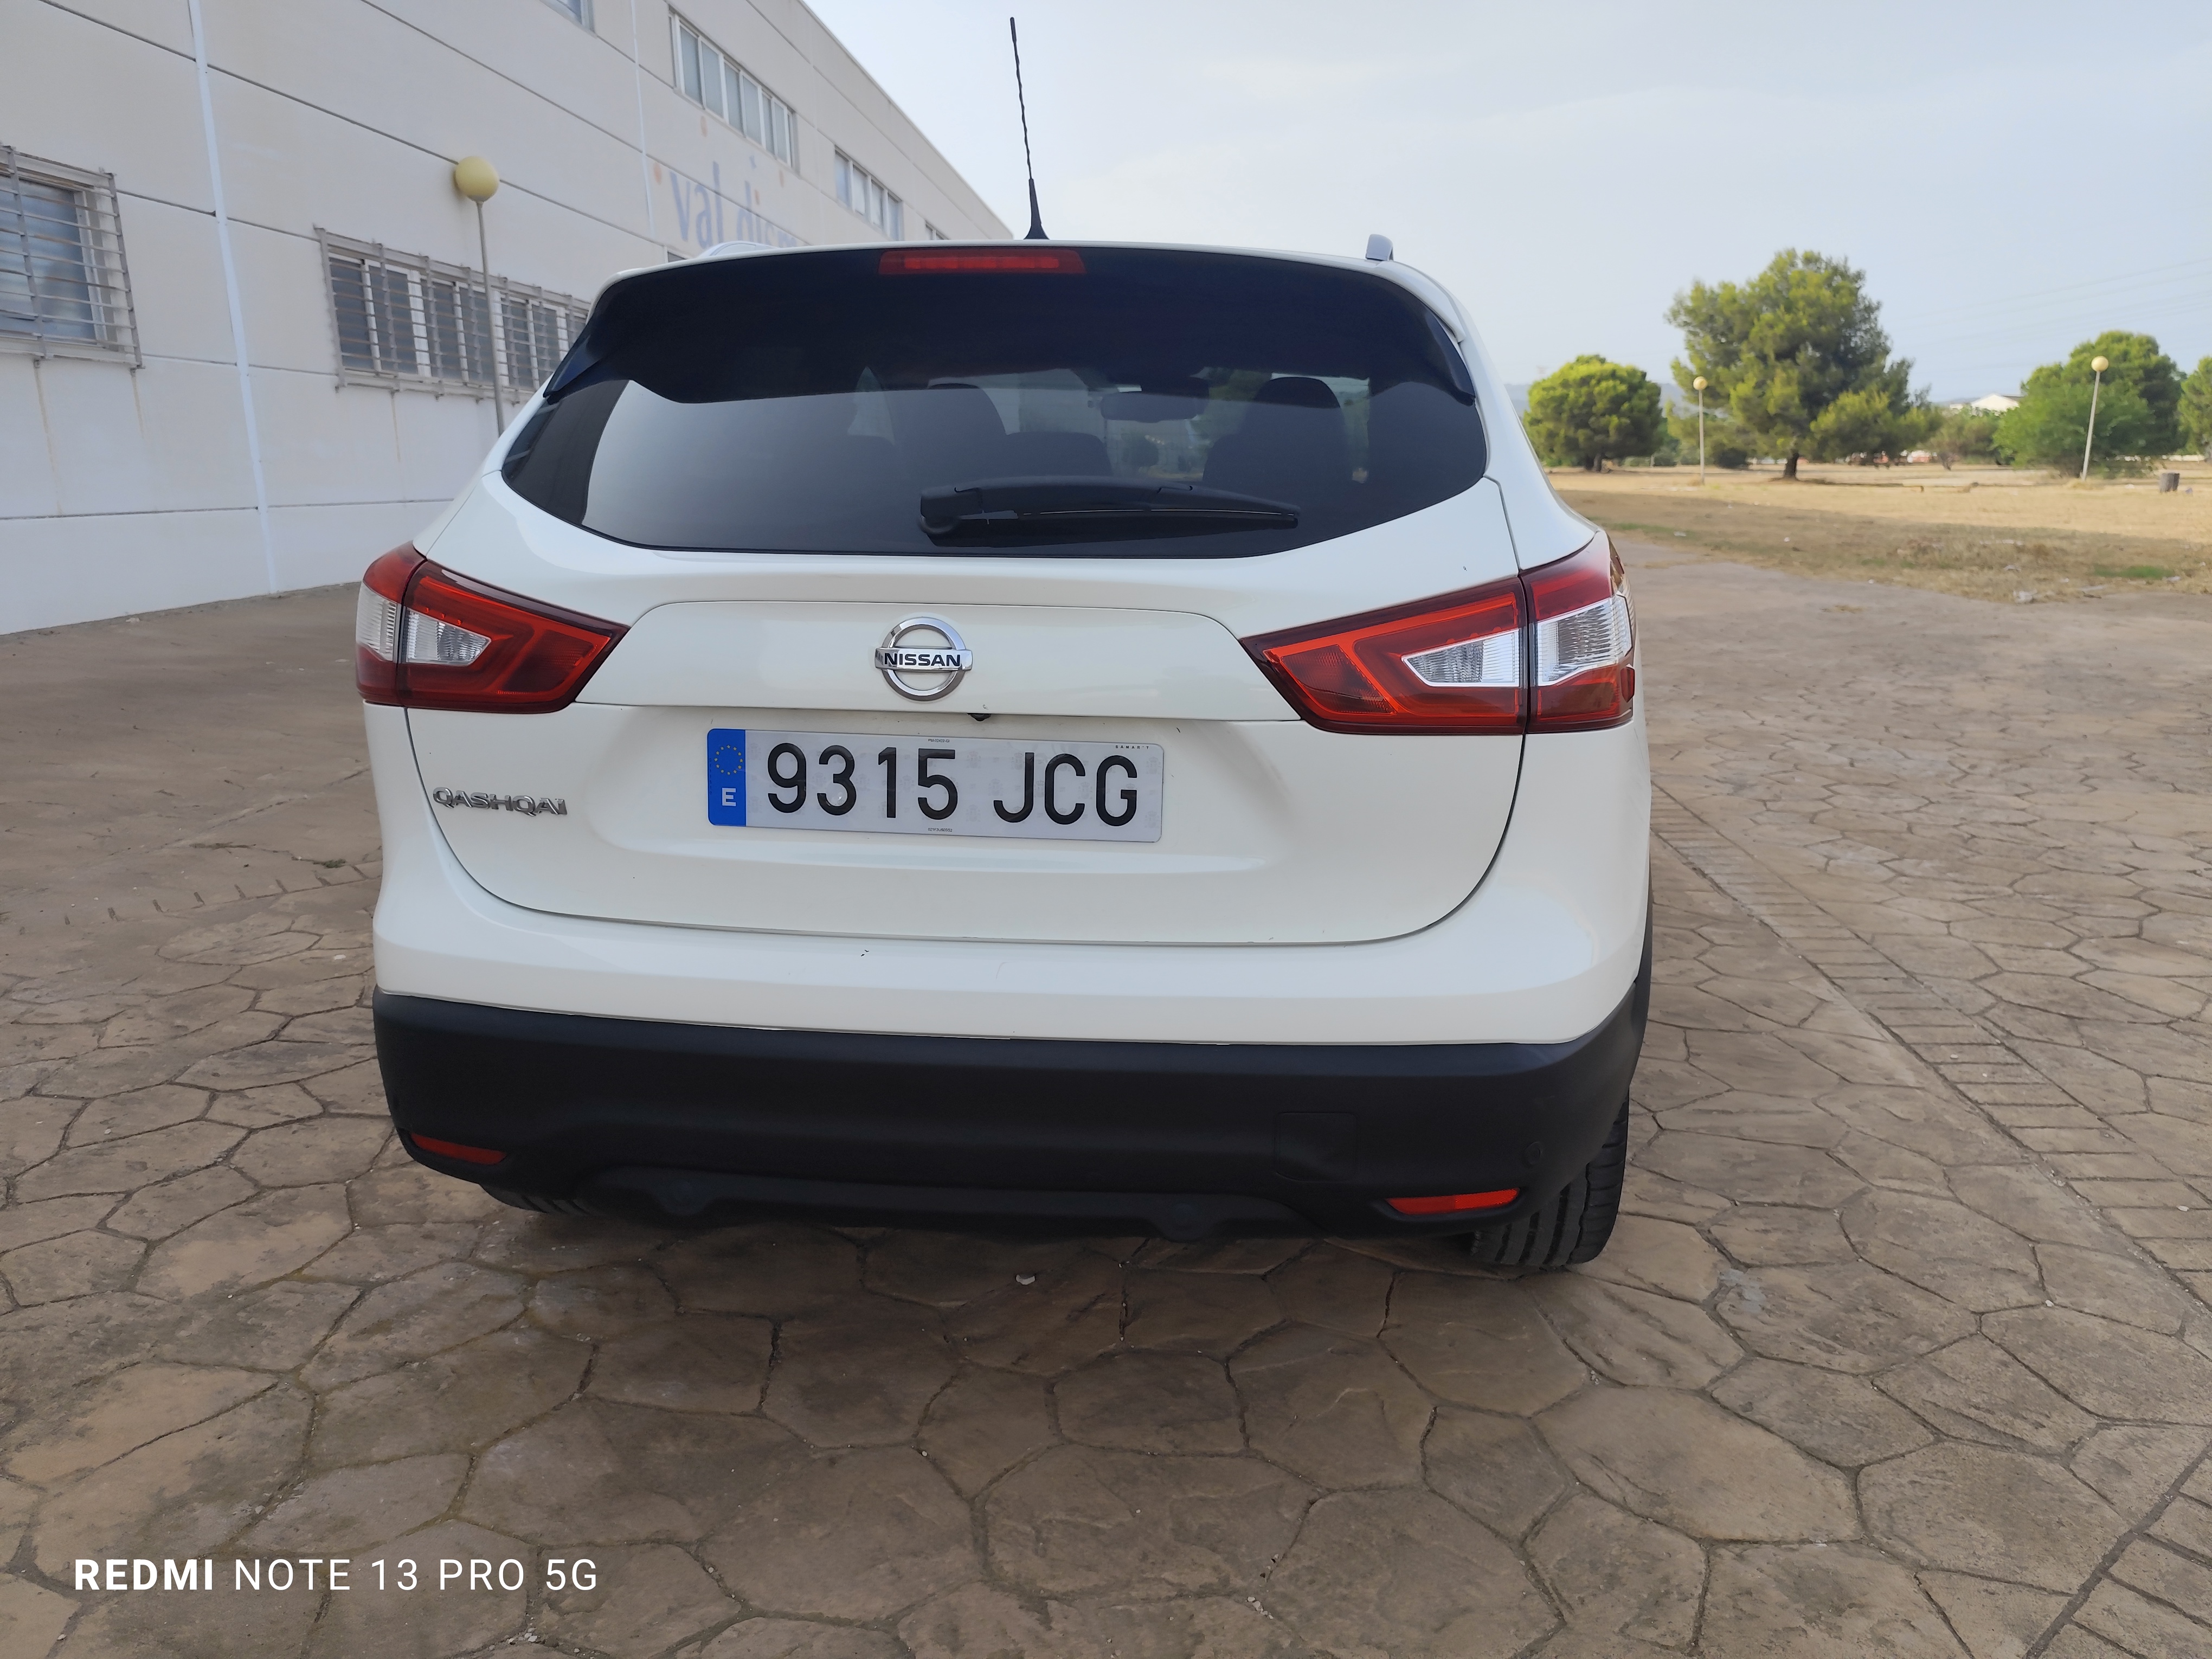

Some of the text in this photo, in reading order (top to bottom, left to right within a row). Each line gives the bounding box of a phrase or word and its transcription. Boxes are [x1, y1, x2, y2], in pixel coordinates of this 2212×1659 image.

[670, 161, 723, 248] val
[884, 653, 960, 667] NISSAN
[722, 787, 736, 807] E
[767, 742, 958, 821] 9315
[993, 752, 1137, 827] JCG
[433, 787, 568, 816] QASHQAI
